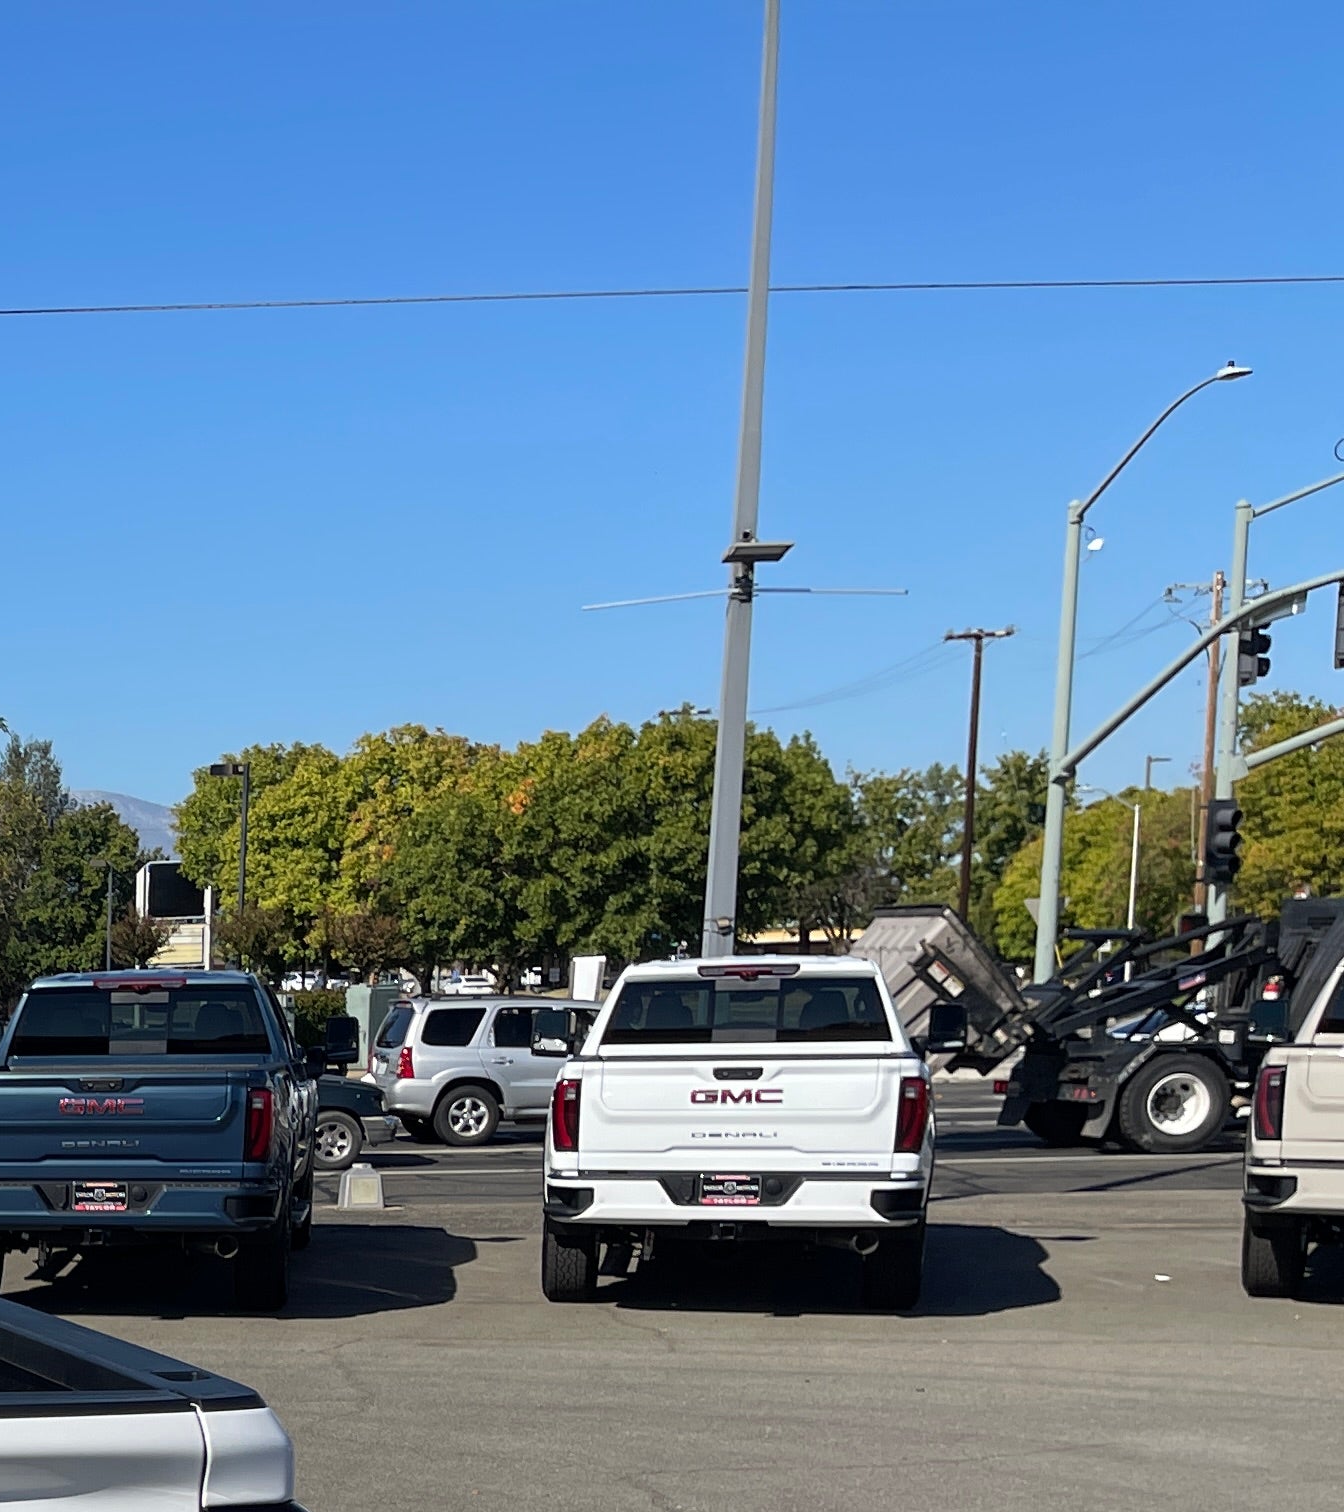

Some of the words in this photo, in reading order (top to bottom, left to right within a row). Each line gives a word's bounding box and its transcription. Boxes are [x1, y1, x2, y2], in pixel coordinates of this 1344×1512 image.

[690, 1088, 784, 1104] GMC
[58, 1097, 145, 1116] GMC
[61, 1138, 140, 1149] DENALI
